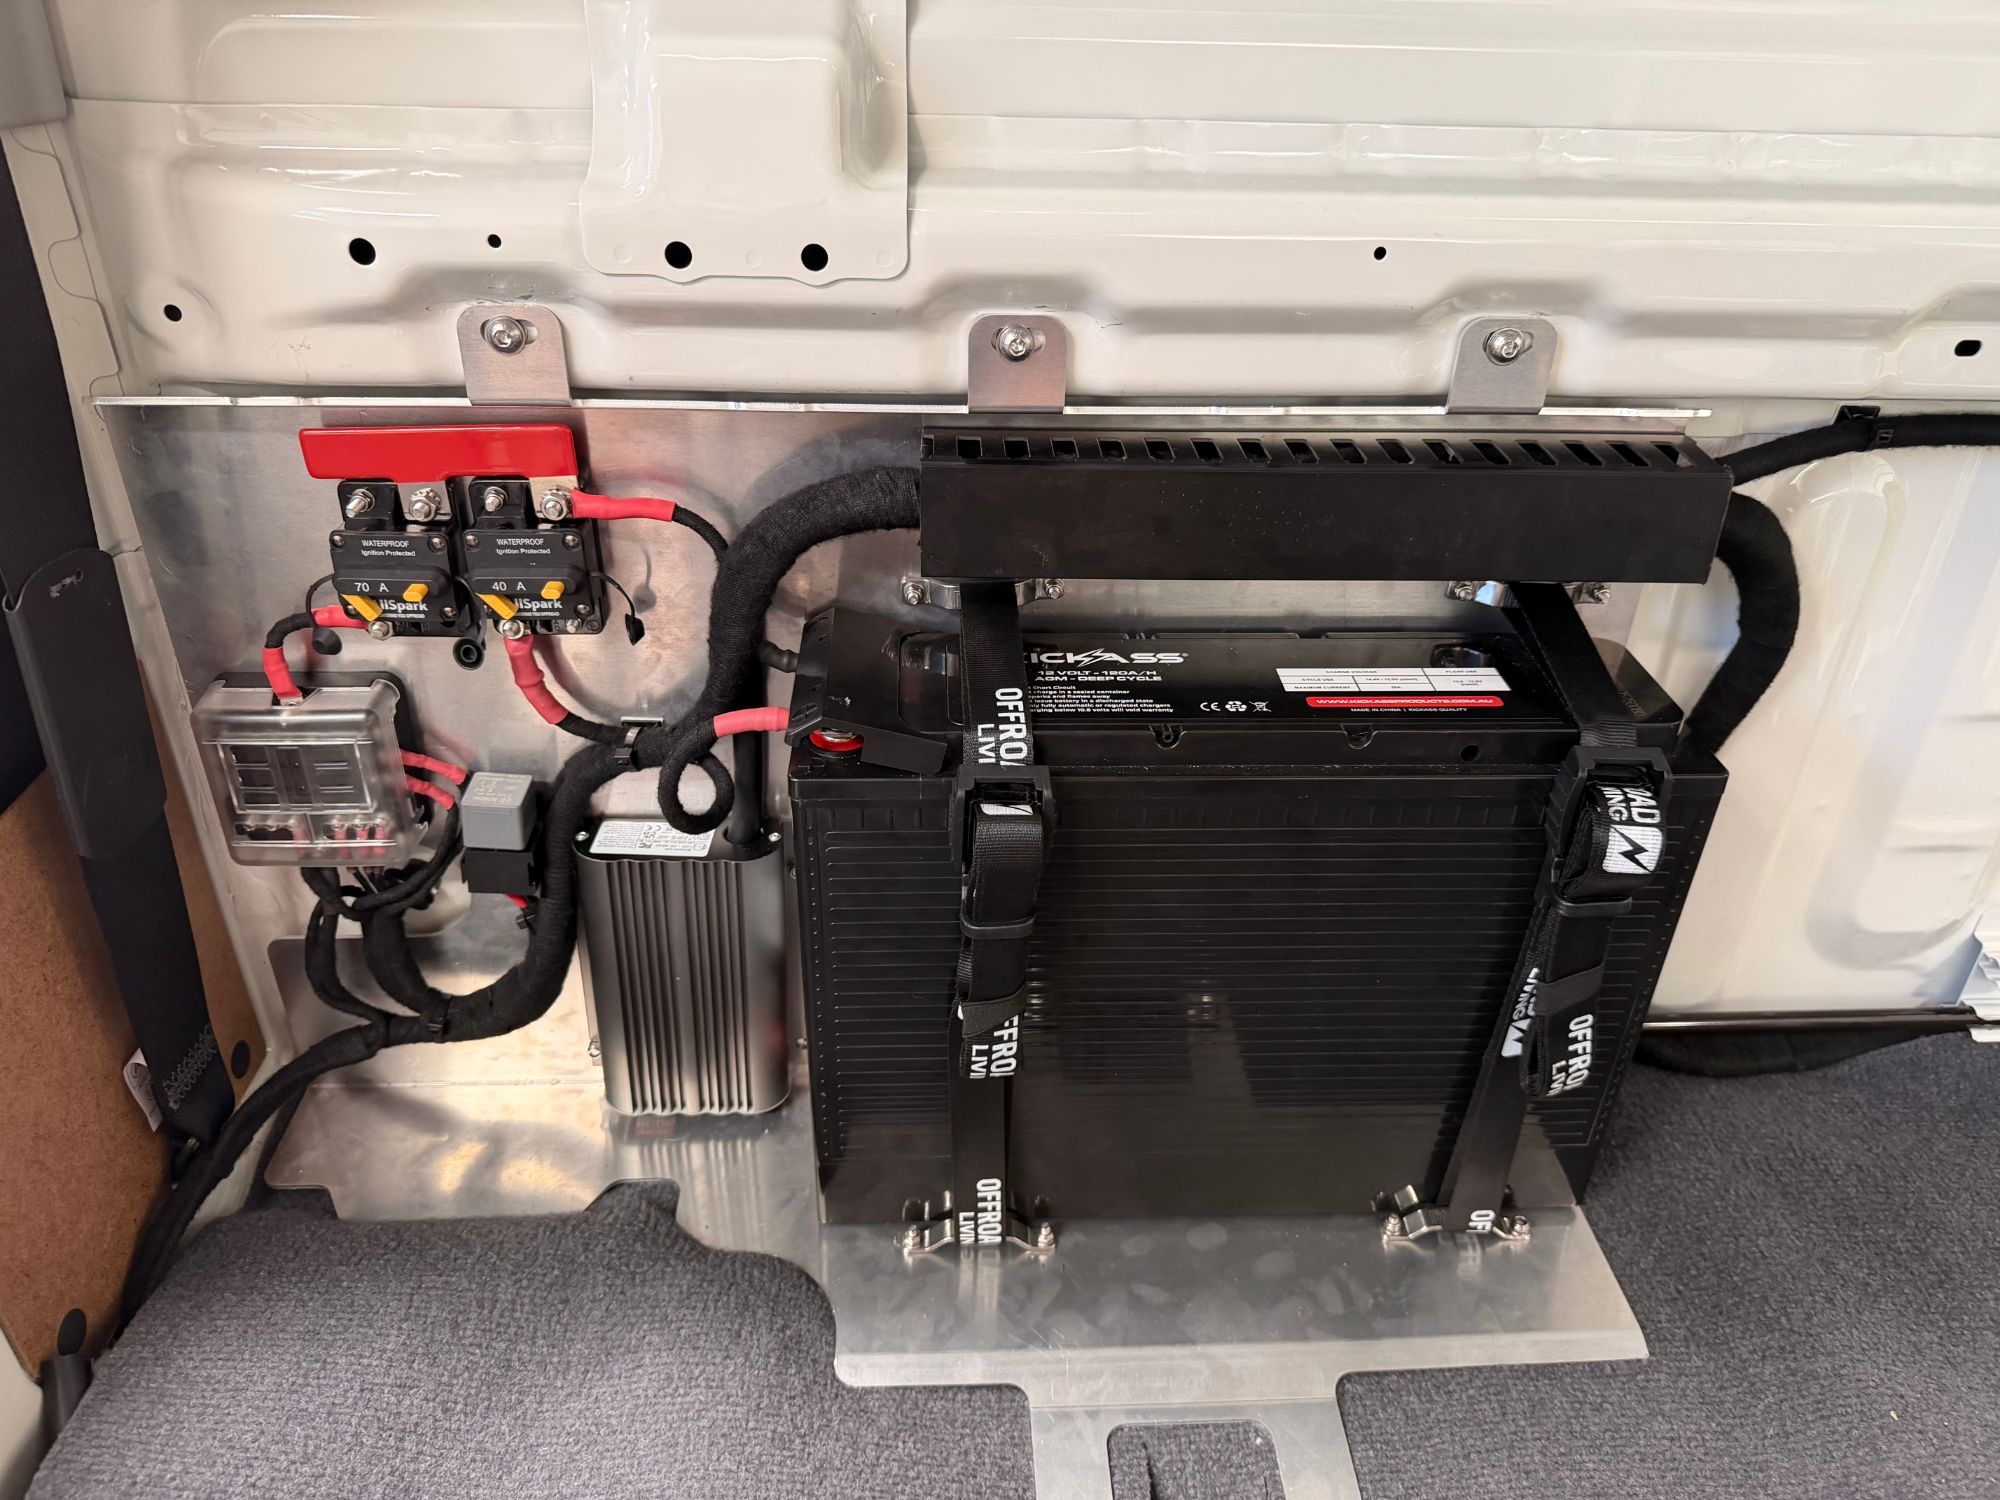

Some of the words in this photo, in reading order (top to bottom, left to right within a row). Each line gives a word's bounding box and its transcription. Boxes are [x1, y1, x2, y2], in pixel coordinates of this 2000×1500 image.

[361, 539, 410, 548] WATERPROOF
[496, 538, 545, 546] WATERPROOF
[360, 549, 385, 557] Ignition
[385, 549, 416, 557] Protected
[495, 547, 520, 556] Ignition
[354, 582, 370, 592] 70
[379, 582, 389, 593] A
[492, 581, 507, 591] 40
[516, 581, 527, 591] A
[379, 598, 429, 612] llSpark
[514, 597, 563, 611] llSpark
[1023, 651, 1184, 665] ICKASS
[1199, 701, 1221, 712] CE
[977, 723, 996, 764] LIVI
[990, 1014, 1019, 1077] FFRO
[976, 1178, 1002, 1244] OFFROA
[959, 1211, 975, 1244] LIVIN
